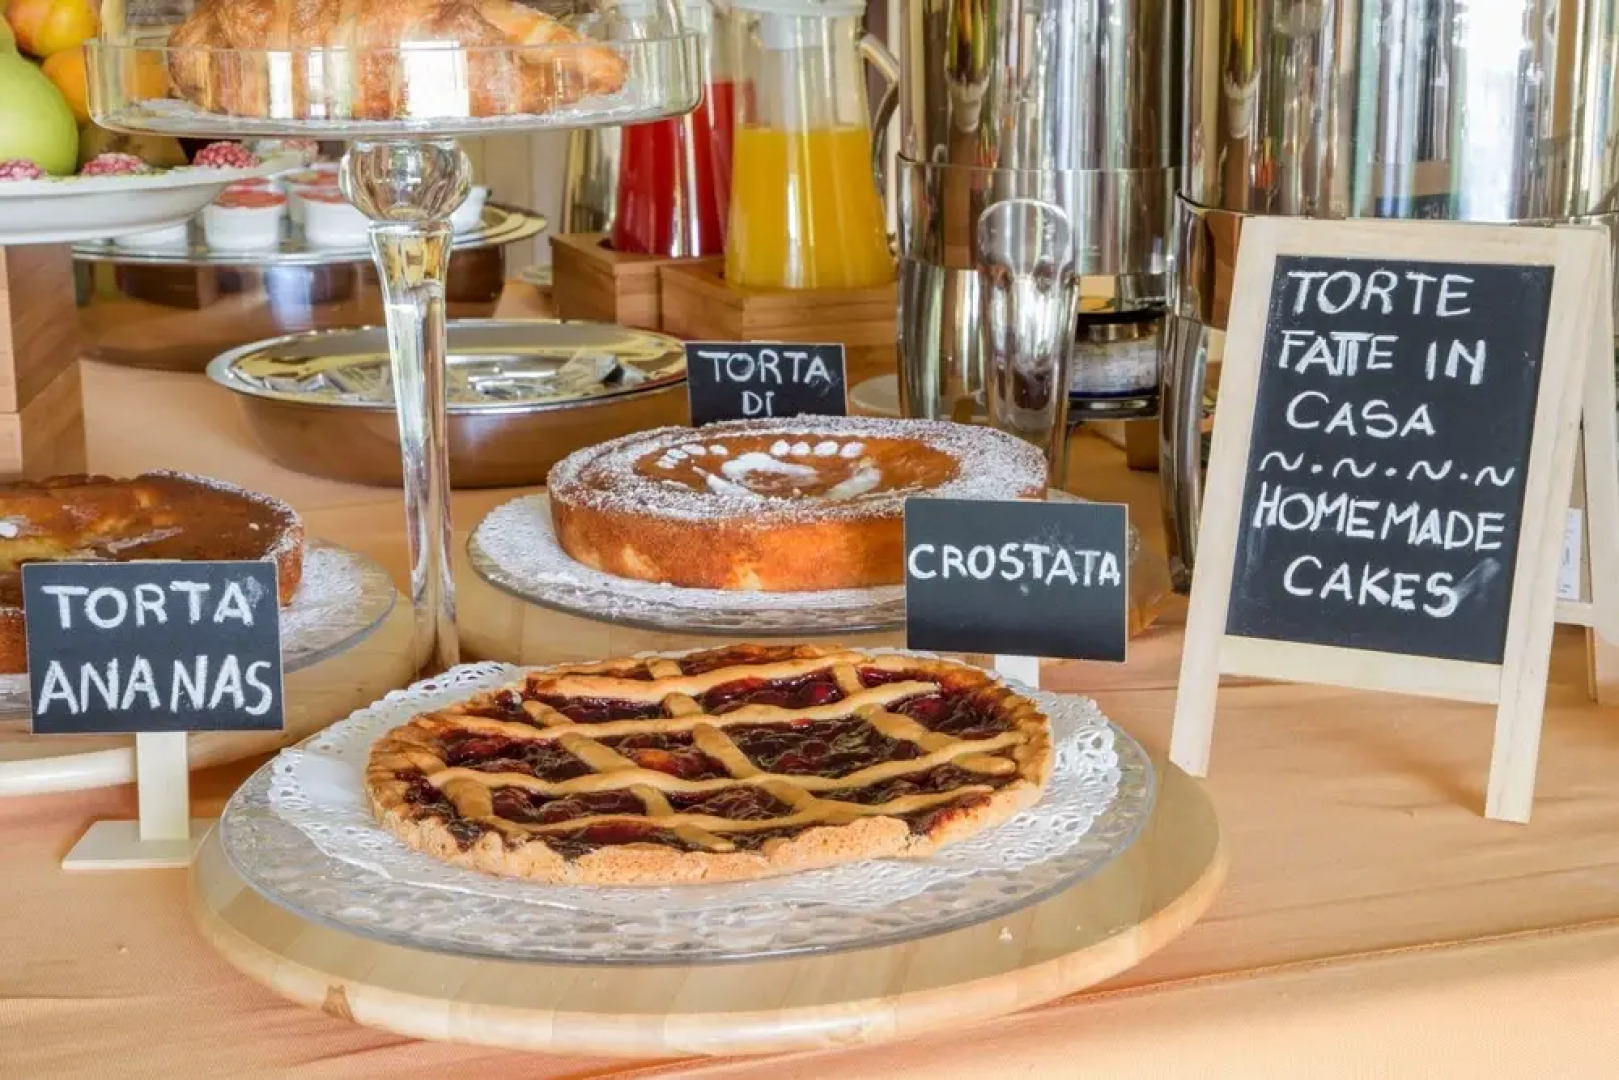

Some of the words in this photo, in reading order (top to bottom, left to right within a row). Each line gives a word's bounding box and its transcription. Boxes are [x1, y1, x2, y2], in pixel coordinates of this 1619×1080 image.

[1288, 269, 1474, 316] TORTE
[697, 349, 832, 385] TORTA
[1278, 329, 1398, 376] FATTE
[1426, 338, 1487, 385] IN
[741, 390, 775, 417] DI
[1285, 391, 1436, 438] CASA
[1252, 481, 1505, 551] HOMEMADE
[907, 542, 1121, 587] CROSTATA
[1283, 555, 1459, 619] CAKES
[41, 580, 255, 629] TORTA
[37, 654, 273, 715] ANANAS
